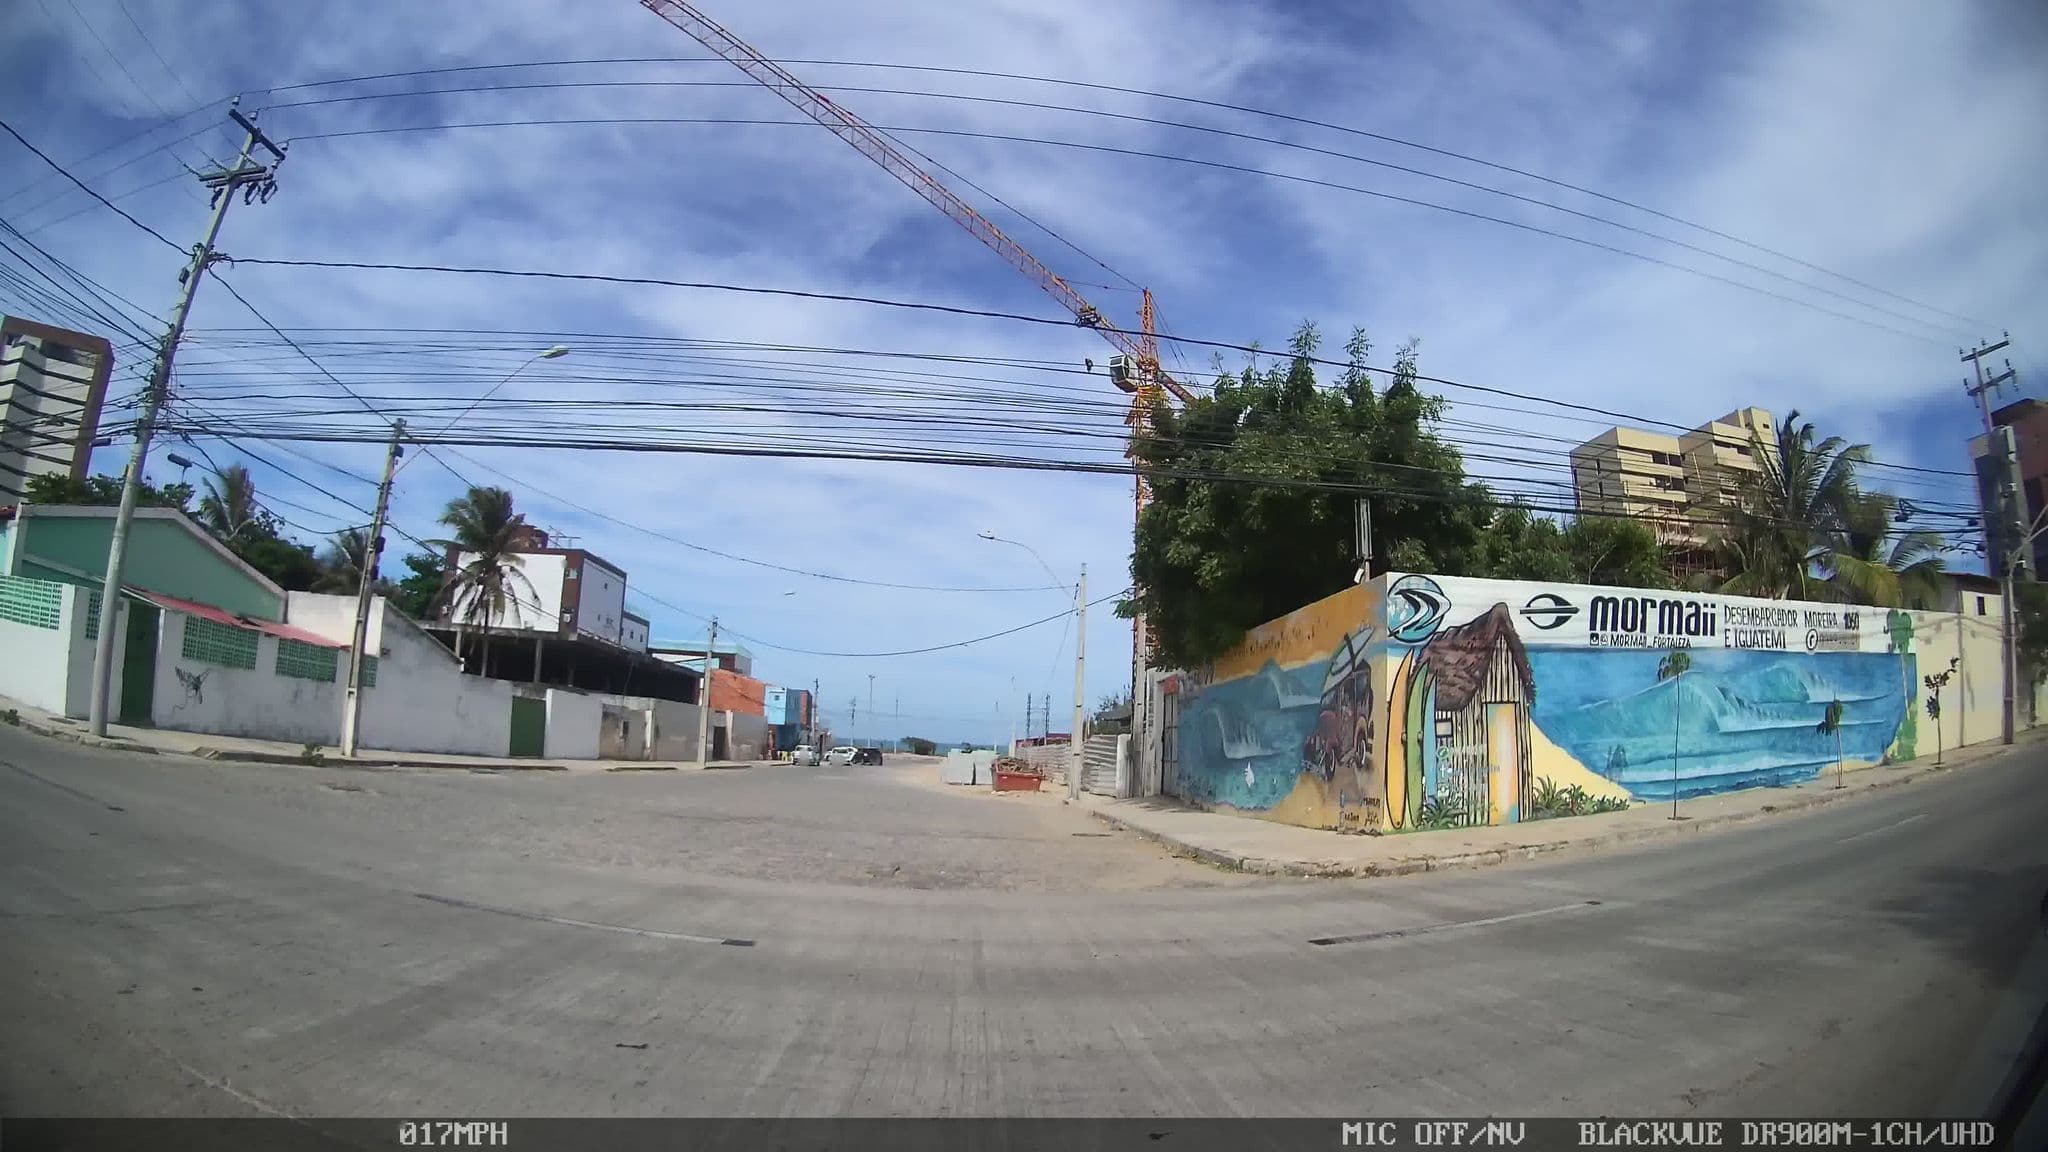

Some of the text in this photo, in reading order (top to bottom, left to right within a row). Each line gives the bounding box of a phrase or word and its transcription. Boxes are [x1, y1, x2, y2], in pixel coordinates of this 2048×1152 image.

[1589, 595, 1715, 636] mormaii
[1724, 604, 1798, 628] DESEMBARCADOR
[1804, 610, 1838, 629] MOREIRA
[1724, 629, 1786, 649] E IGUATEMI
